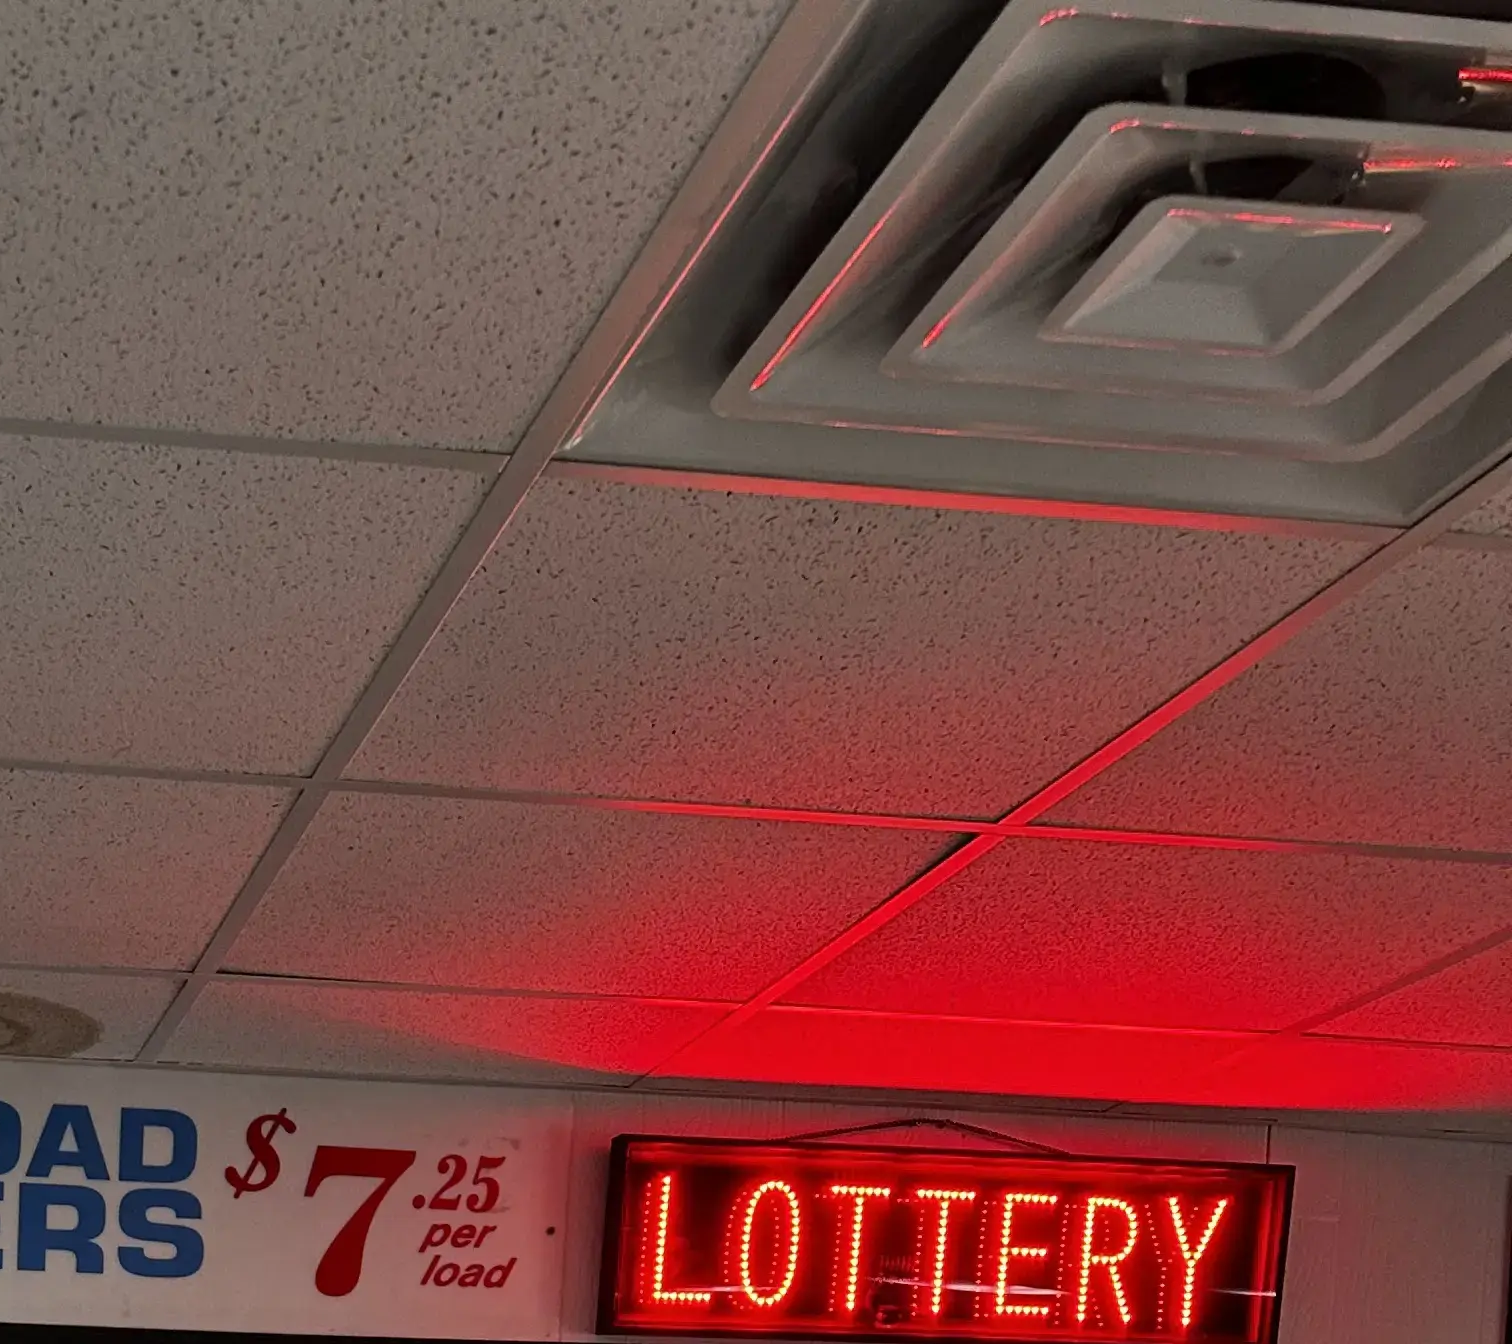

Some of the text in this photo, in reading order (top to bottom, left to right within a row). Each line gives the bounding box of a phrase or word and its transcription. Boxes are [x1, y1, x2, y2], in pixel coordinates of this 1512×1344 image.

[419, 1222, 496, 1253] per
[651, 1174, 1228, 1327] LOTTERY
[420, 1257, 517, 1290] load
